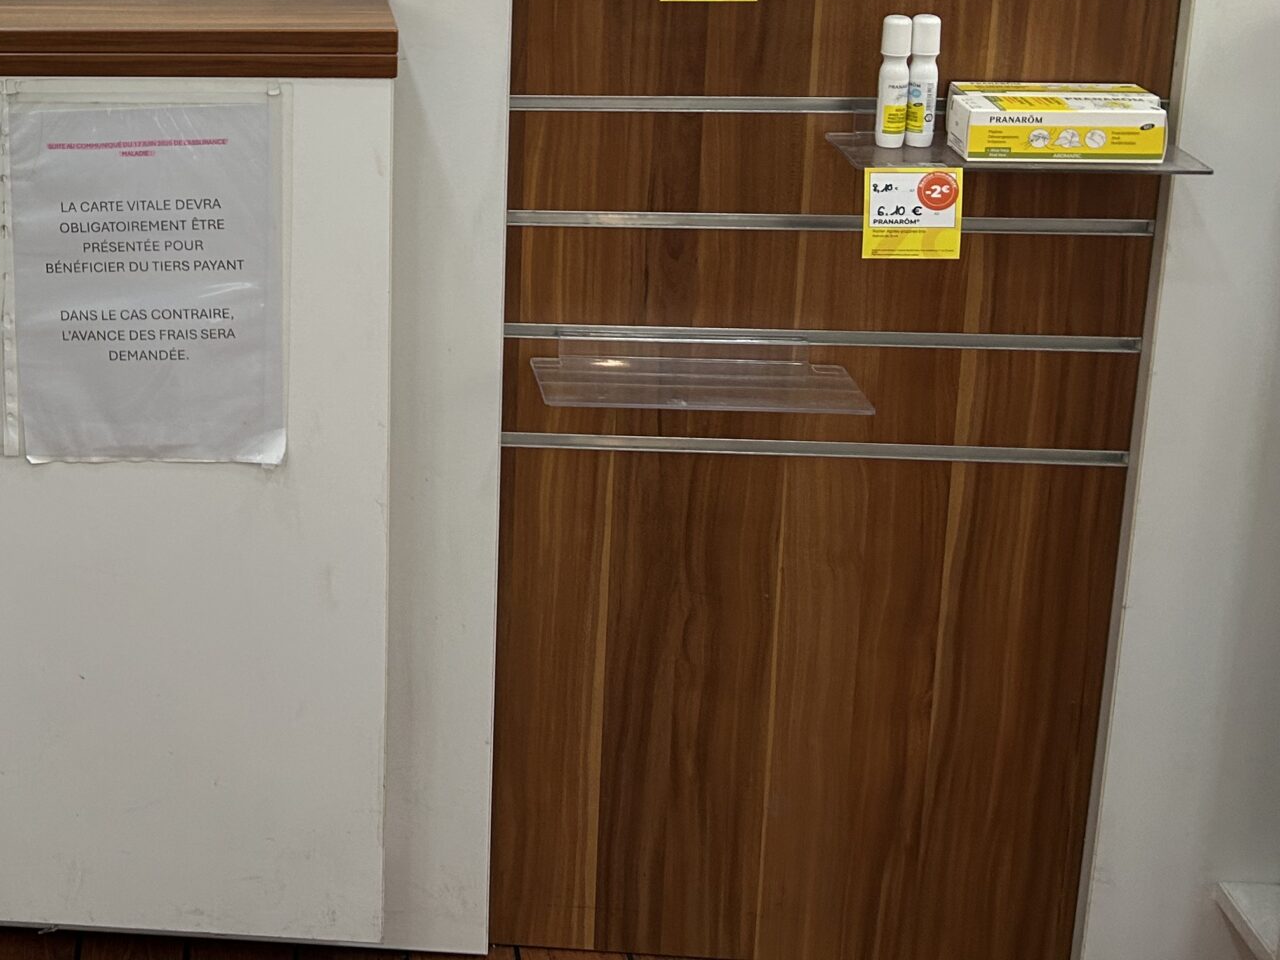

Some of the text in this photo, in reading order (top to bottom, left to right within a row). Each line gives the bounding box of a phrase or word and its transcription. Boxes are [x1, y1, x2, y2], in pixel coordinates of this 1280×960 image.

[989, 114, 1043, 125] PRANARÔM
[61, 198, 221, 213] LA CARTE VITALE DEVRA
[912, 206, 922, 216] €
[59, 217, 225, 233] OBLIGATOIREMENT ÊTRE
[83, 239, 204, 253] PRÉSENTÉE POUR
[45, 259, 245, 274] BÉNÉFICIER DU TIERS PAYANT
[60, 307, 235, 322] DANS LE CAS CONTRAIRE,
[62, 328, 235, 342] L'AVANCE DES FRAIS SERA
[108, 346, 190, 361] DEMANDÉE.
